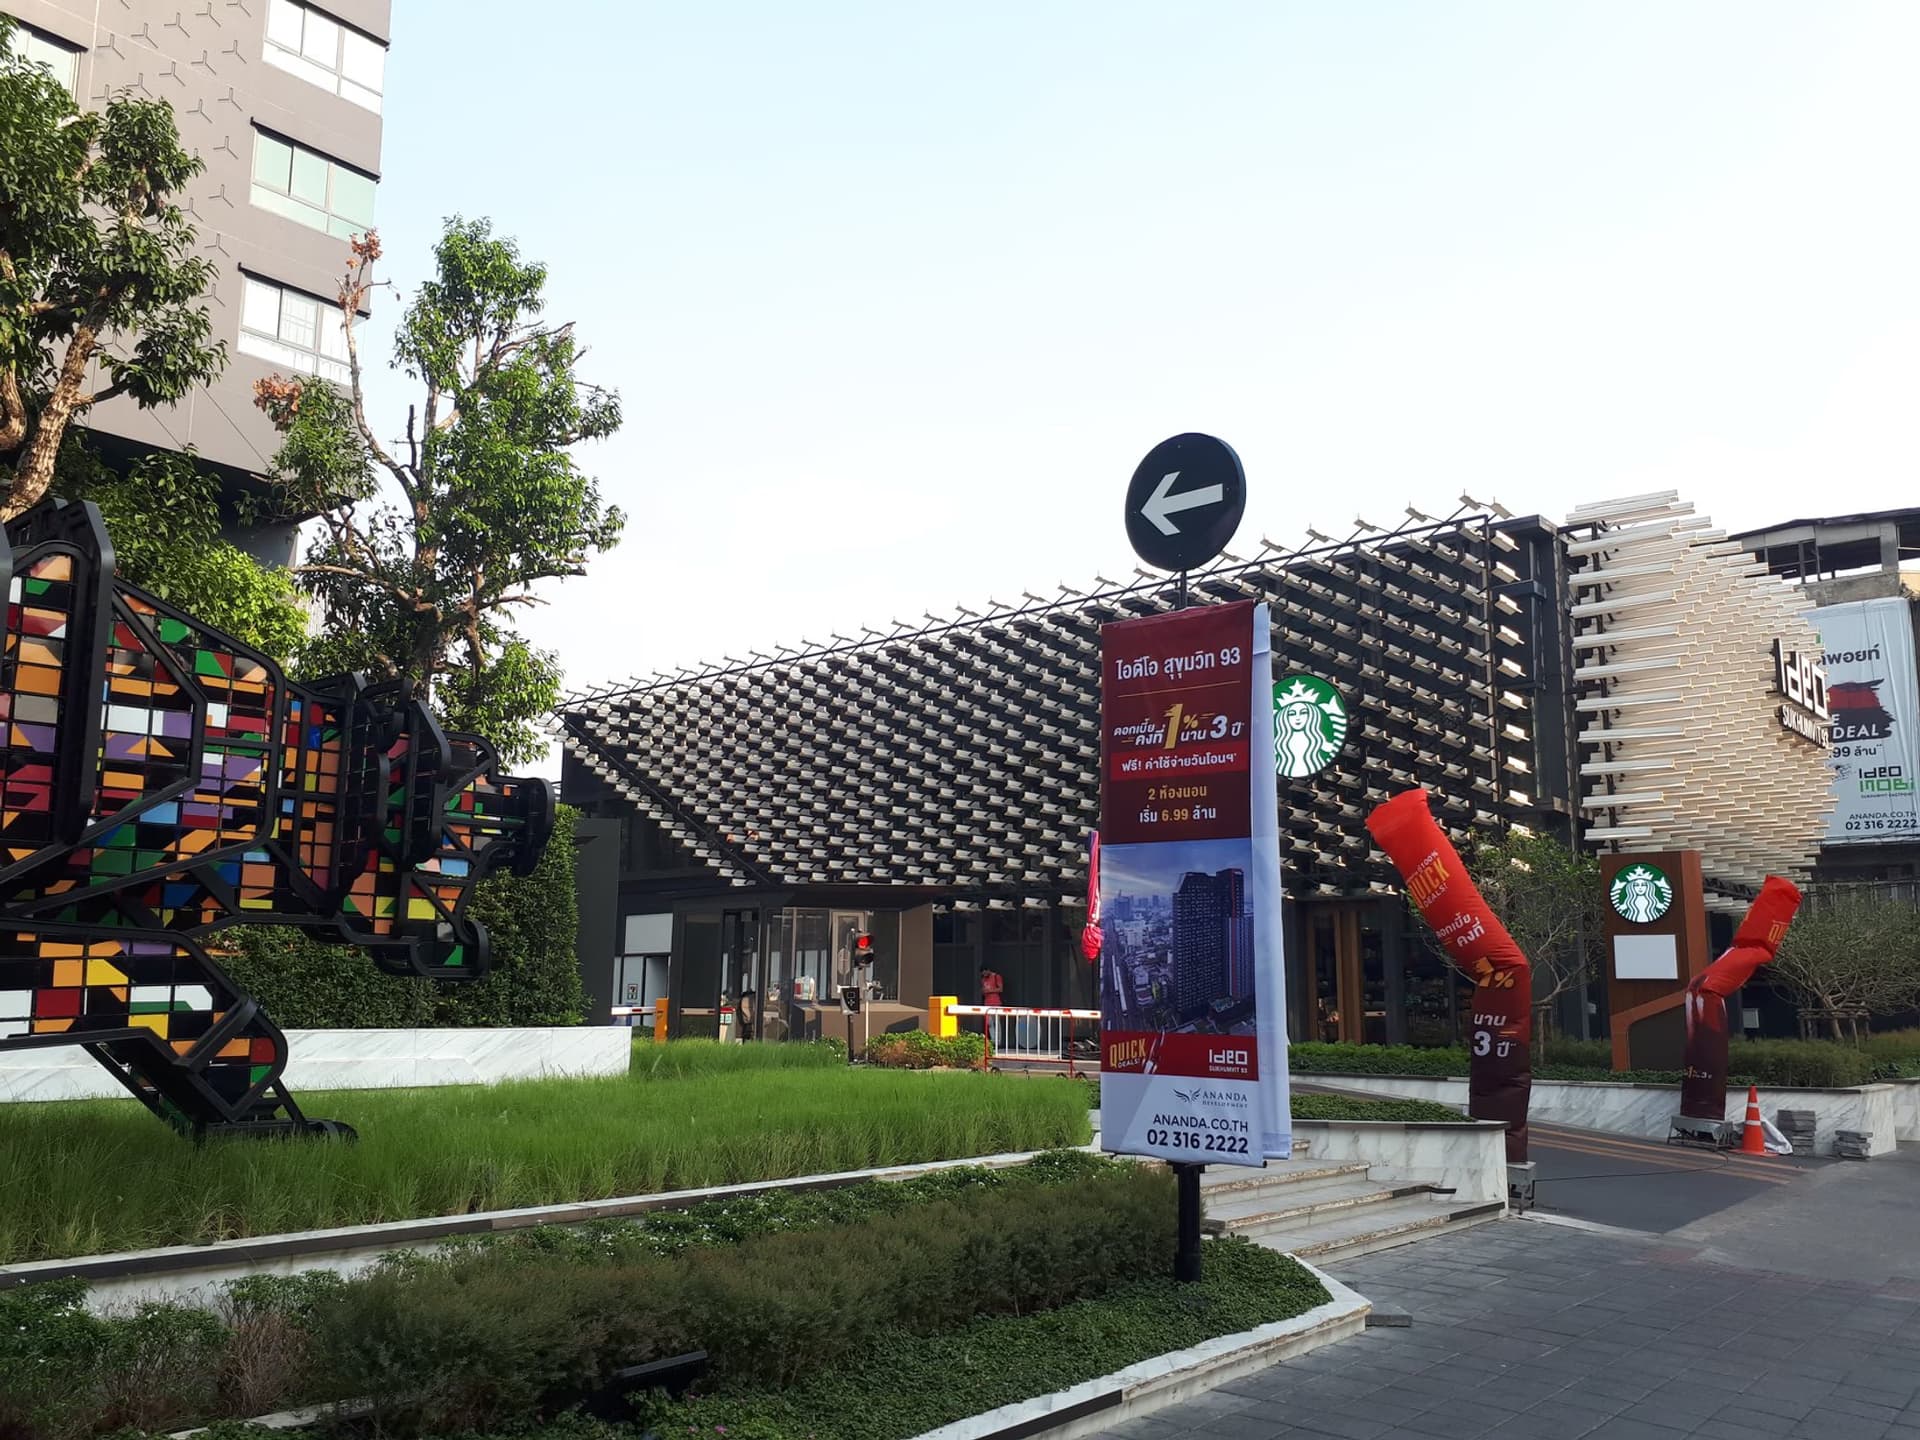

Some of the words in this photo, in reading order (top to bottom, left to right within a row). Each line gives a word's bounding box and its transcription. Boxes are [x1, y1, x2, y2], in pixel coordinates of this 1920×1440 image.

[1116, 655, 1158, 680] ไอดีโอ
[1164, 650, 1215, 679] สุขุมวิท
[1220, 647, 1241, 666] 93
[1114, 718, 1155, 736] ดอกเบี้ย
[1135, 724, 1166, 745] คงที่
[1180, 730, 1206, 742] นาน
[1210, 715, 1228, 739] 3
[1781, 705, 1821, 744] SUKHUMVIT
[1829, 746, 1851, 758] .99
[1122, 759, 1142, 772] ฟรี!
[1148, 788, 1156, 800] 2
[1160, 785, 1207, 799] ห้องนอน
[1139, 805, 1158, 823] เริ่ม
[1161, 808, 1189, 821] 6.99
[1192, 805, 1216, 820] ล้าน
[1849, 811, 1917, 820] ANANDA.CO.TH
[1845, 821, 1861, 830] 02
[1864, 820, 1884, 830] 316
[1887, 818, 1918, 829] 2222
[1457, 916, 1486, 947] คงที่
[1474, 1013, 1506, 1026] นาน
[1473, 1031, 1491, 1057] 3
[1110, 1038, 1146, 1069] QUICK
[1202, 1091, 1248, 1102] ANANDA
[1153, 1114, 1248, 1133] ANANDA.CO.TH
[1147, 1129, 1168, 1146] 02
[1172, 1132, 1200, 1149] 316
[1205, 1134, 1249, 1154] 2222
